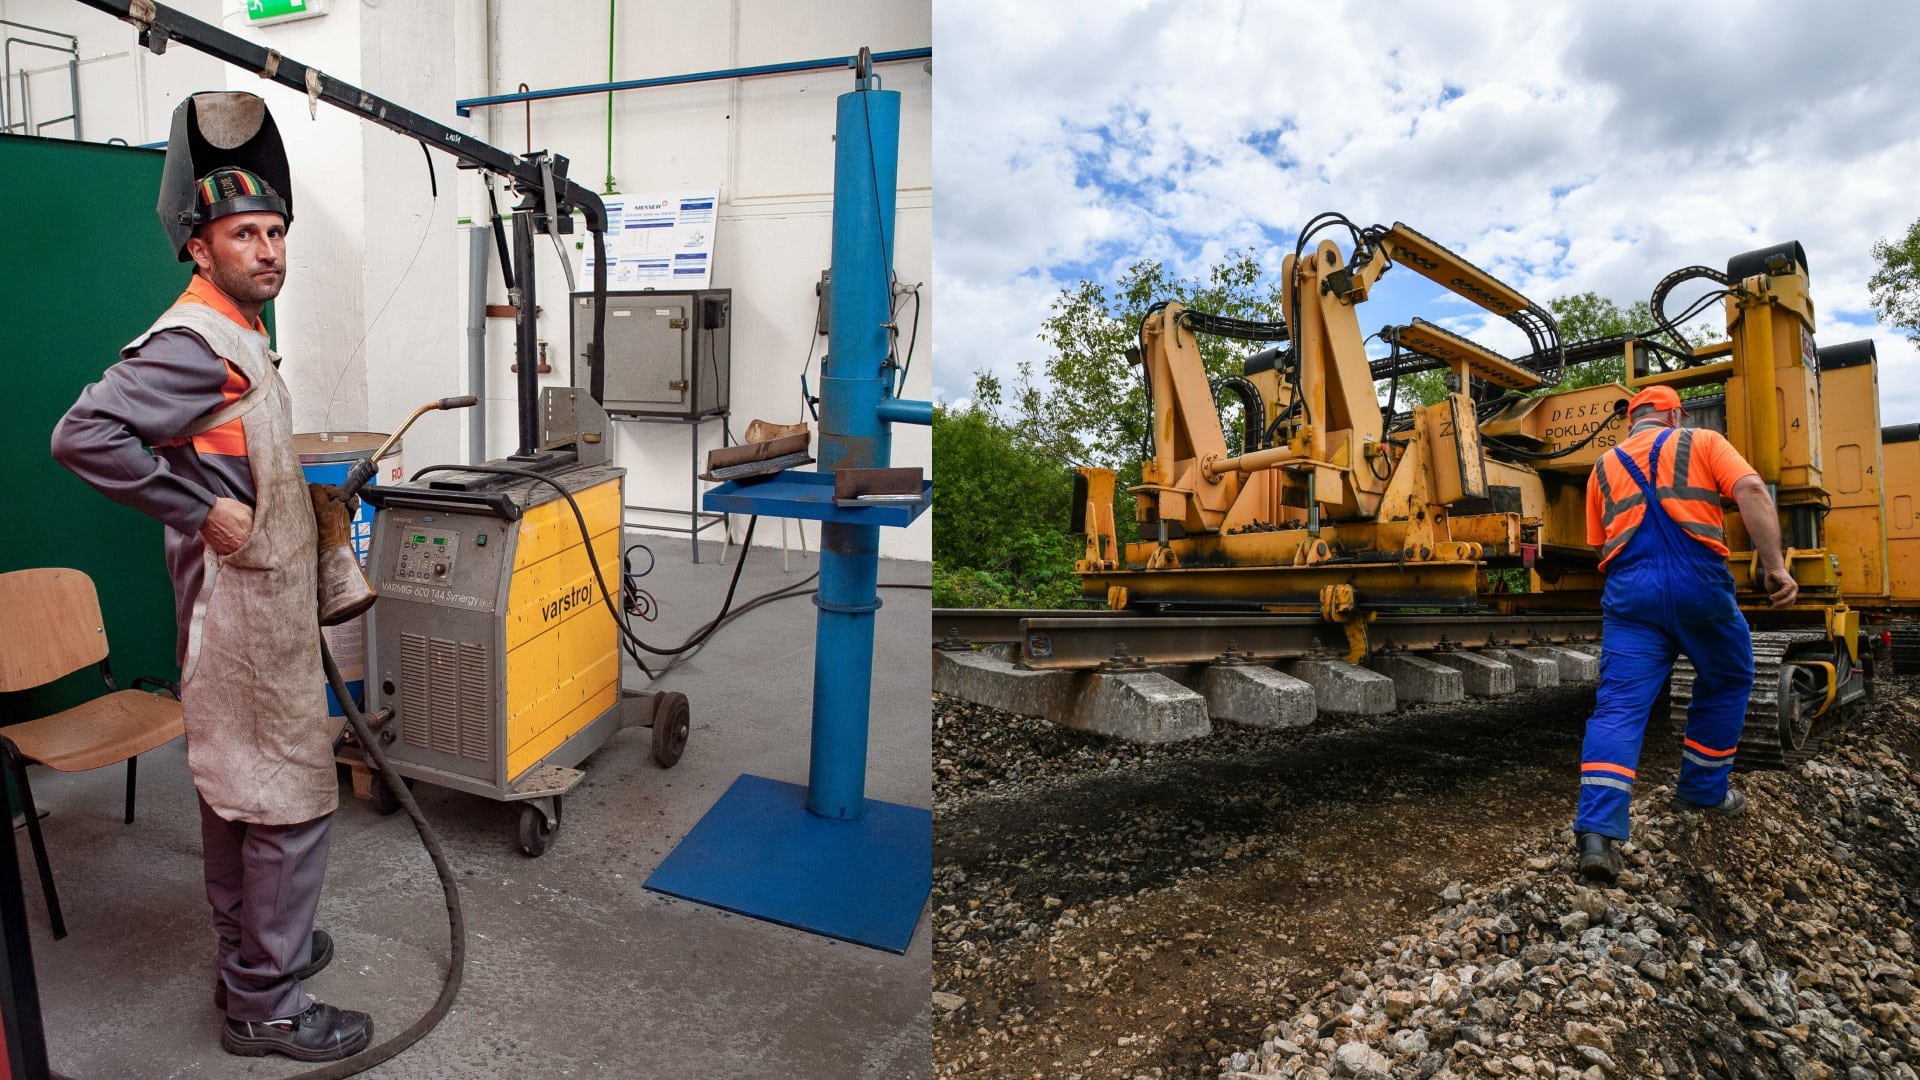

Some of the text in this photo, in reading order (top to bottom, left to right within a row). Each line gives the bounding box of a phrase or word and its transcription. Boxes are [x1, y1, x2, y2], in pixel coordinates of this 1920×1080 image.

[1552, 401, 1614, 422] DESEC
[1791, 418, 1800, 430] 4
[1591, 435, 1617, 449] TSS
[1866, 466, 1874, 475] 4
[382, 582, 412, 595] VARMIG
[414, 587, 429, 598] 600
[446, 591, 480, 607] Synergy
[542, 577, 592, 622] varstroj
